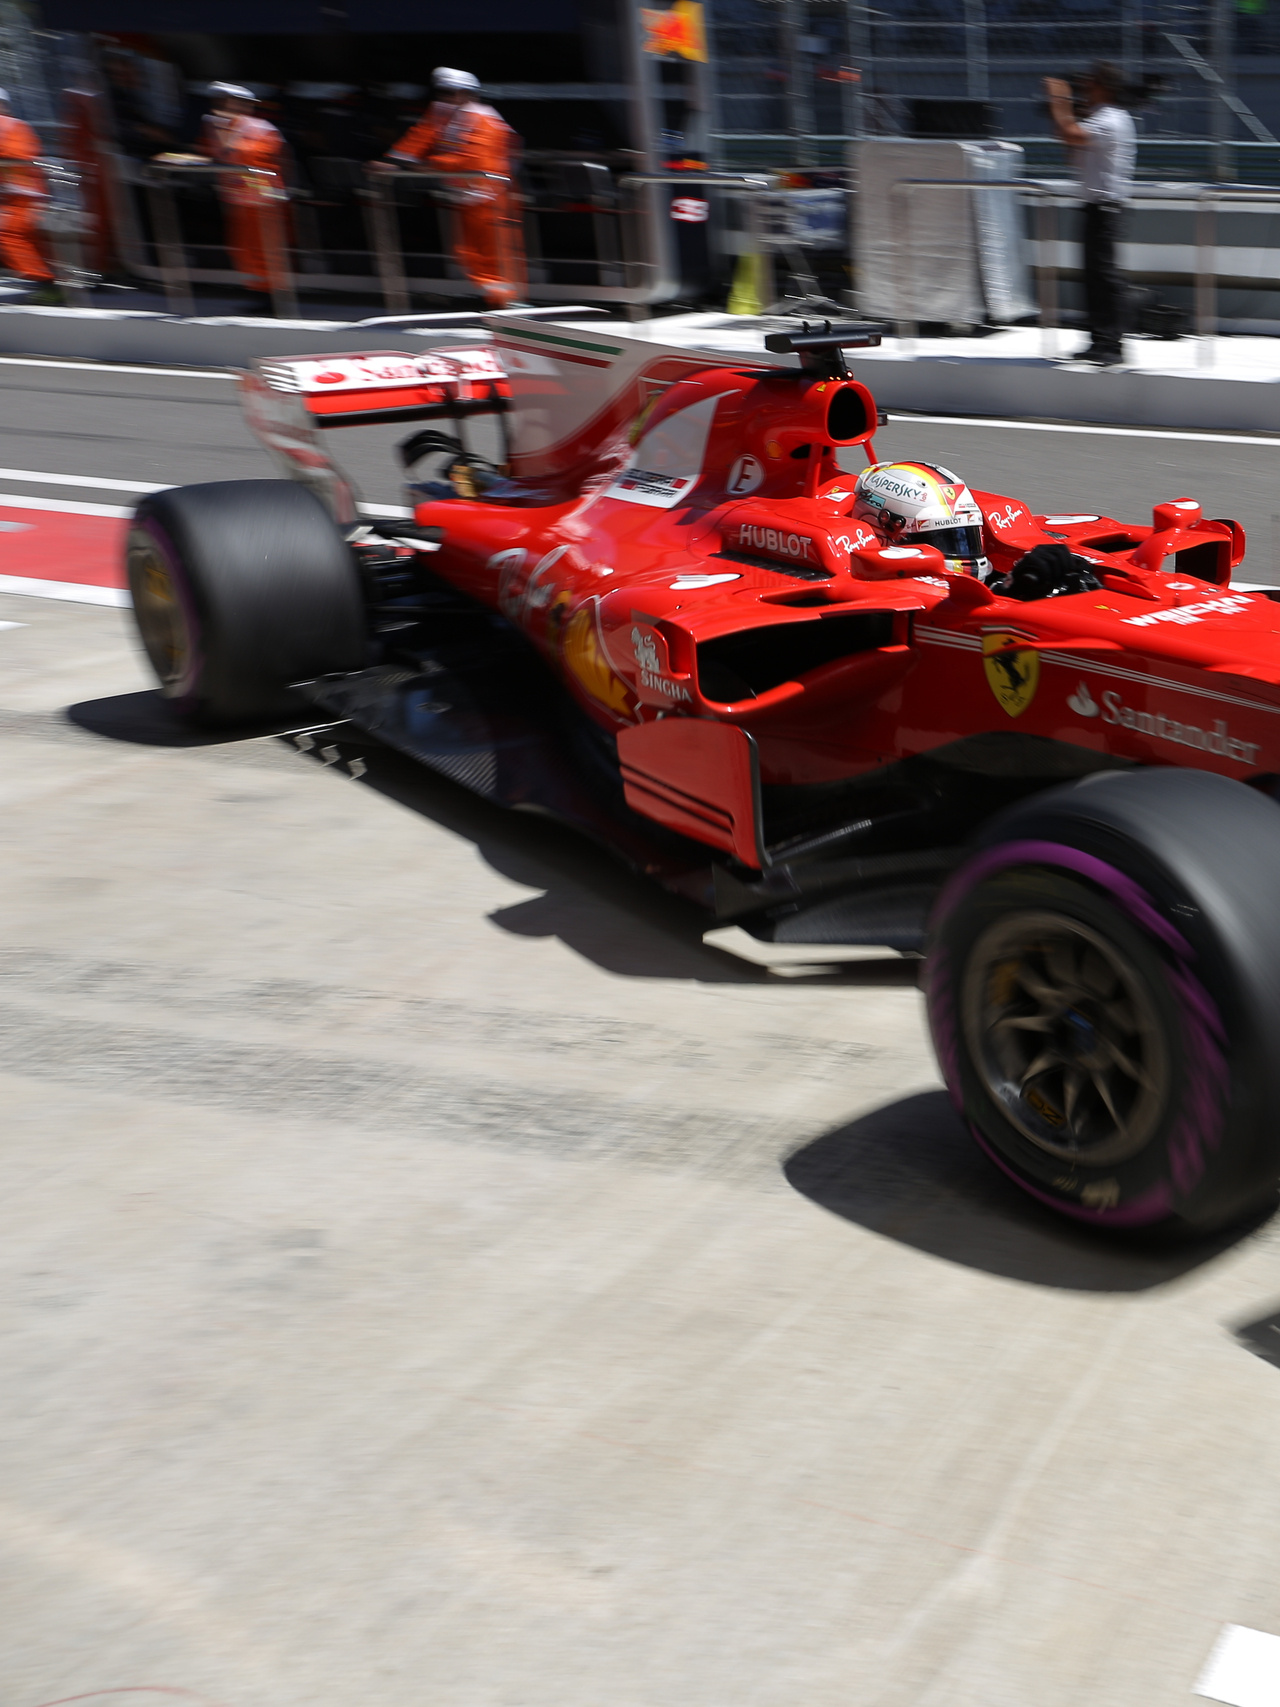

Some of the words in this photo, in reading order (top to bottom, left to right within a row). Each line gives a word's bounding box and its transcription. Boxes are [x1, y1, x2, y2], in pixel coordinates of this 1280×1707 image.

[870, 473, 921, 498] KASPERSKY
[934, 517, 962, 527] HUBLOT
[739, 523, 812, 559] HUBLOT
[641, 669, 694, 704] SINGHA
[1101, 690, 1263, 766] Santander
